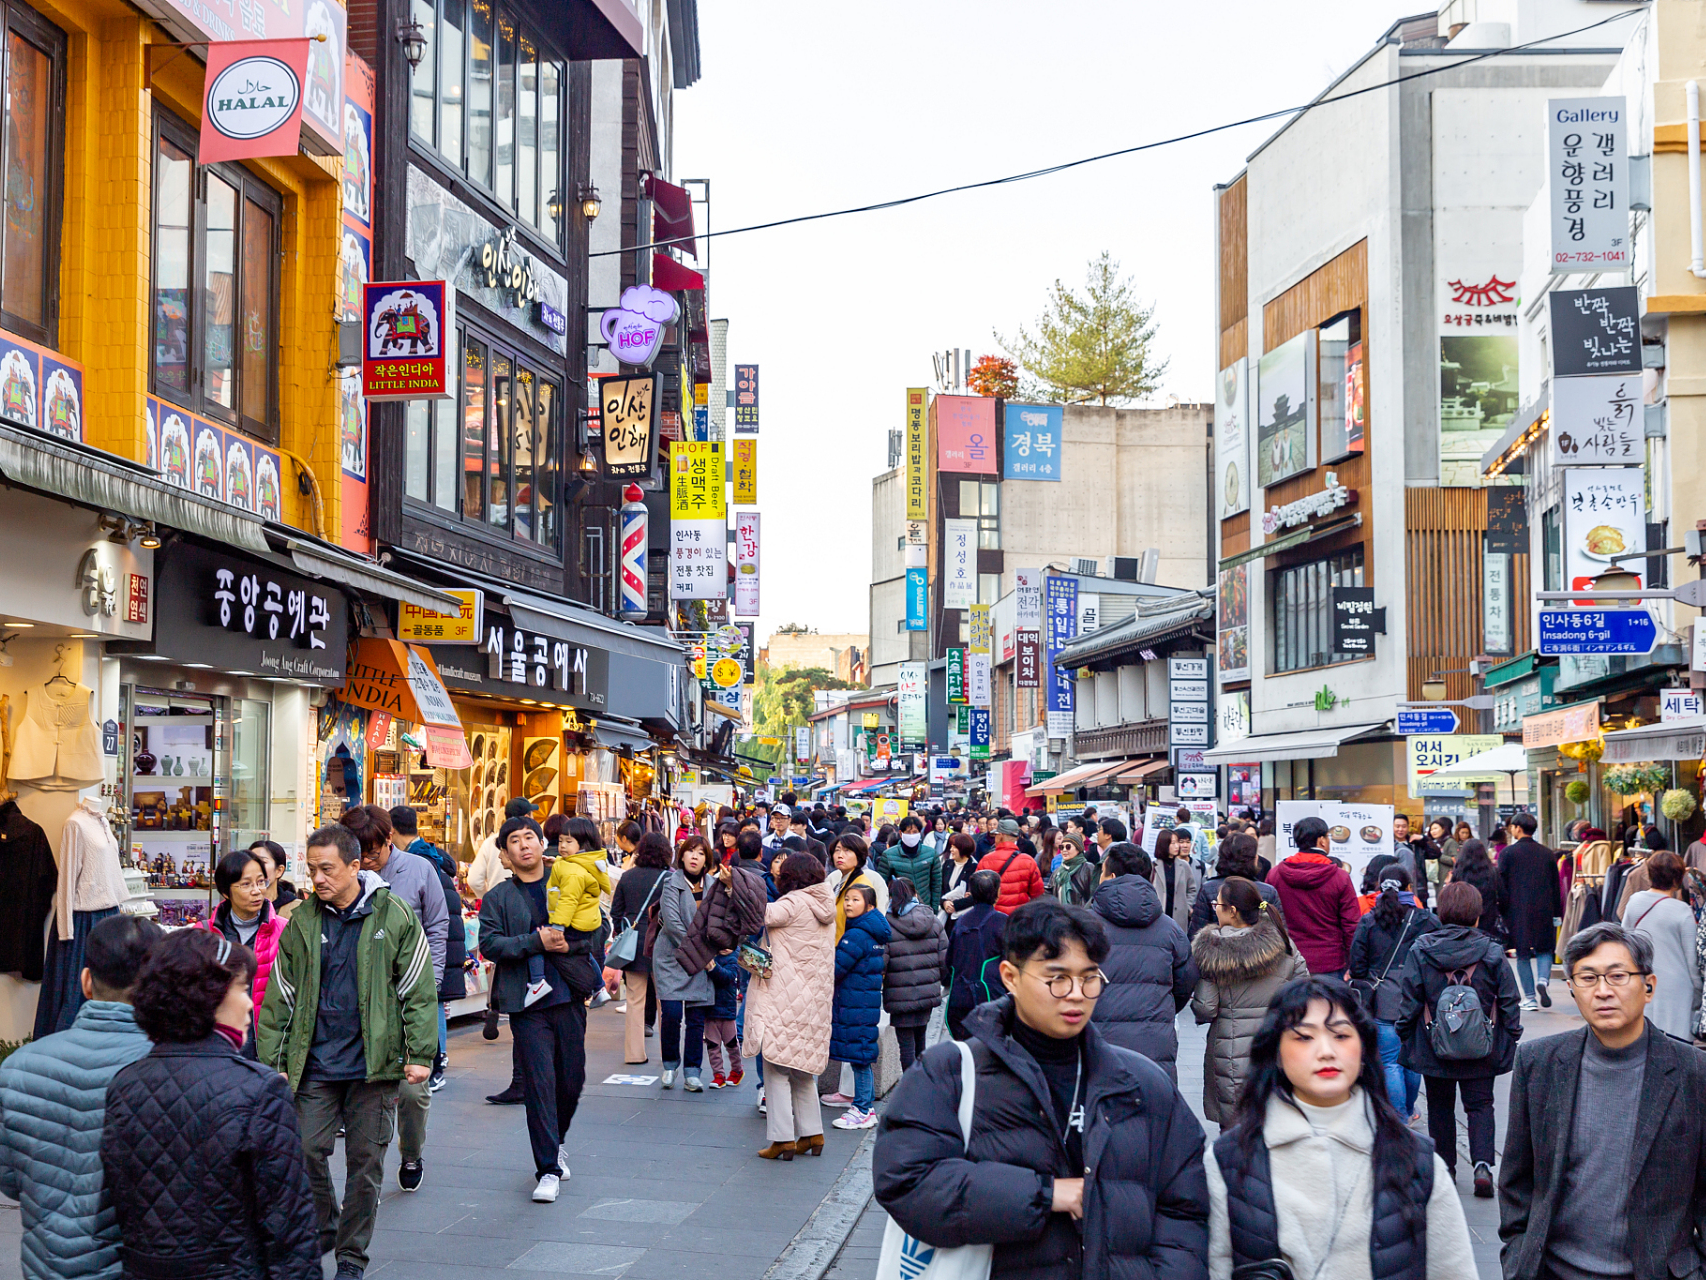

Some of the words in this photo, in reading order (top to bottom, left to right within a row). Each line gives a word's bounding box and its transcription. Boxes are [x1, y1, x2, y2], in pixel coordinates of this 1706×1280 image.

[202, 3, 236, 41] DRINKS
[238, 79, 271, 94] حلال
[217, 96, 289, 111] HALAL
[1557, 109, 1618, 123] Gallery
[1592, 133, 1615, 209] 갤러리
[1561, 134, 1585, 241] 운향풍경
[1611, 239, 1623, 247] 3F
[1555, 252, 1625, 263] 02-732-1041
[1574, 294, 1609, 314] 반짝
[1600, 314, 1635, 338] 반짝
[619, 330, 654, 348] HOF
[374, 362, 434, 378] 작은인디아
[369, 380, 406, 390] LITTLE
[408, 379, 440, 388] INDIA
[607, 380, 646, 423] 인산
[1608, 382, 1639, 428] 흙
[609, 424, 647, 462] 인해
[676, 443, 708, 453] HOF
[965, 433, 989, 460] 올
[1011, 431, 1056, 458] 경북
[1582, 431, 1638, 457] 사람들
[945, 450, 965, 459] 갤러리
[711, 457, 720, 481] Draft
[1013, 463, 1036, 473] 갤러리
[691, 458, 706, 510] 생맥주
[711, 486, 720, 509] Beer
[676, 530, 701, 542] 인사동
[739, 525, 758, 557] 한강
[676, 547, 702, 560] 풍경이
[705, 547, 722, 559] 있는
[955, 534, 967, 578] 정성호
[676, 565, 693, 577] 전통
[131, 575, 147, 598] 천연
[676, 582, 694, 593] 커피
[1489, 570, 1502, 619] 전통차
[130, 600, 147, 622] 염색
[214, 568, 331, 650] 중앙공예관
[1017, 595, 1039, 609] 전각
[413, 624, 444, 636] 골동품
[455, 627, 468, 636] 3F
[1542, 613, 1605, 628] 인사동6길
[1018, 633, 1039, 644] 대익
[1543, 631, 1586, 641] Insadong
[1588, 631, 1611, 641] 6-gil
[261, 650, 280, 674] Joong
[281, 655, 293, 676] Ang
[293, 657, 309, 673] Craft
[1021, 646, 1035, 679] 보이차
[346, 660, 400, 689] LITTLE
[1664, 698, 1700, 713] 세탁
[371, 713, 386, 744] HALAL
[106, 736, 115, 751] 27
[1415, 741, 1442, 753] 어서
